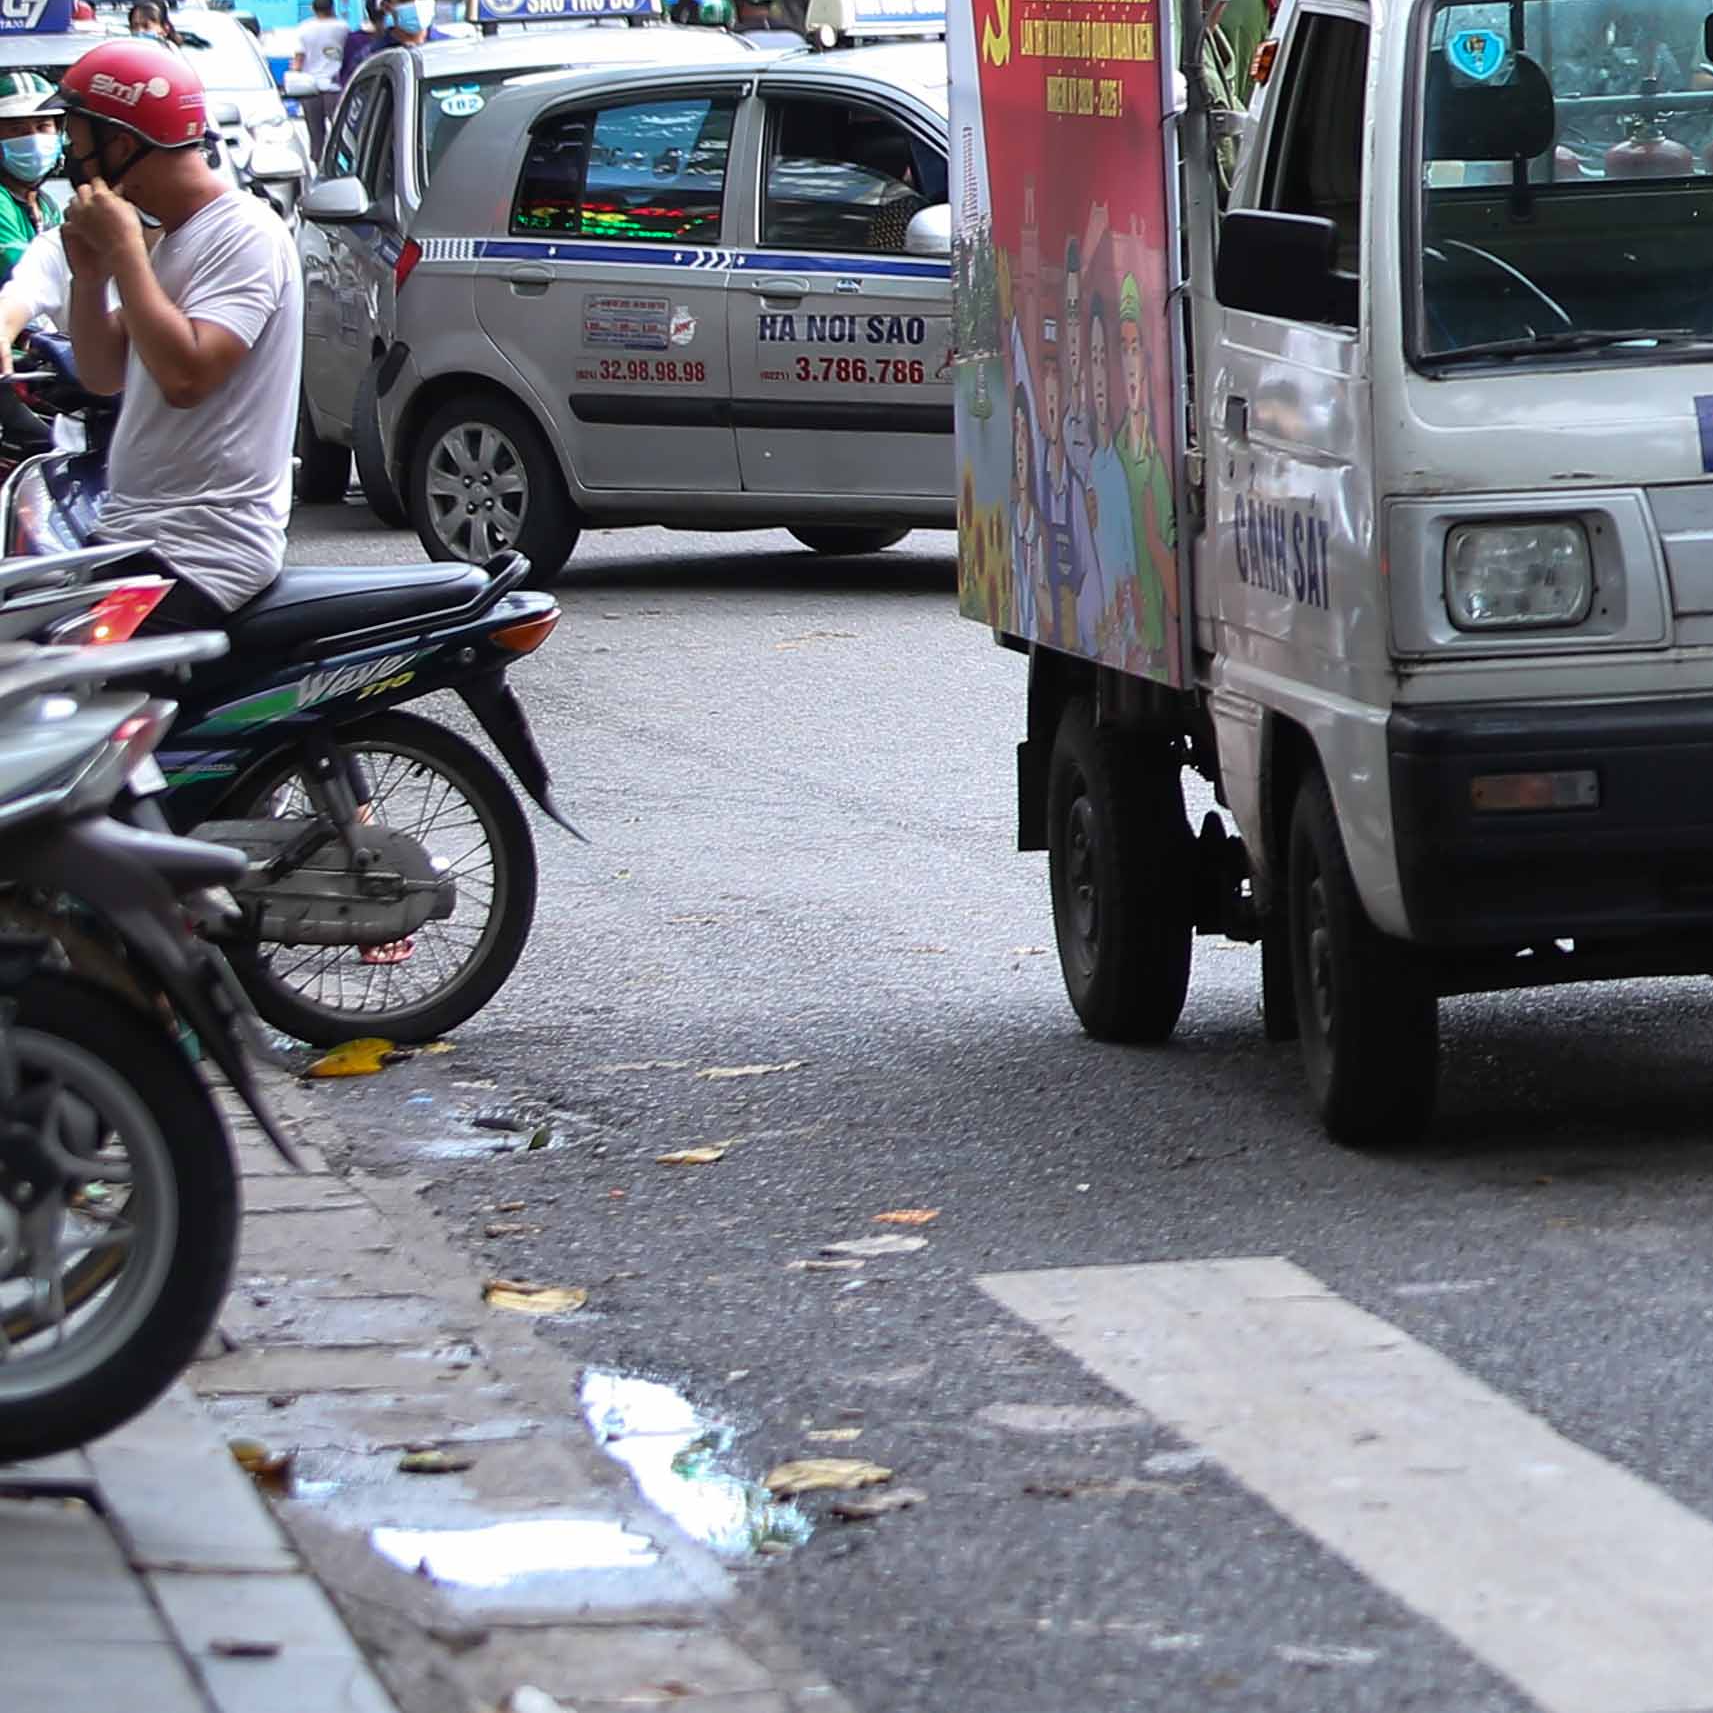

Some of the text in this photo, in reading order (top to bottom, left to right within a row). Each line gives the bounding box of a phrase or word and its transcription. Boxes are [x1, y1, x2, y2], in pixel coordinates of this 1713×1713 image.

[866, 316, 925, 344] SAO
[600, 359, 705, 382] 32.98.98.98
[796, 356, 924, 383] 3.786.786
[1293, 493, 1328, 611] SÁT
[298, 653, 417, 707] Wave
